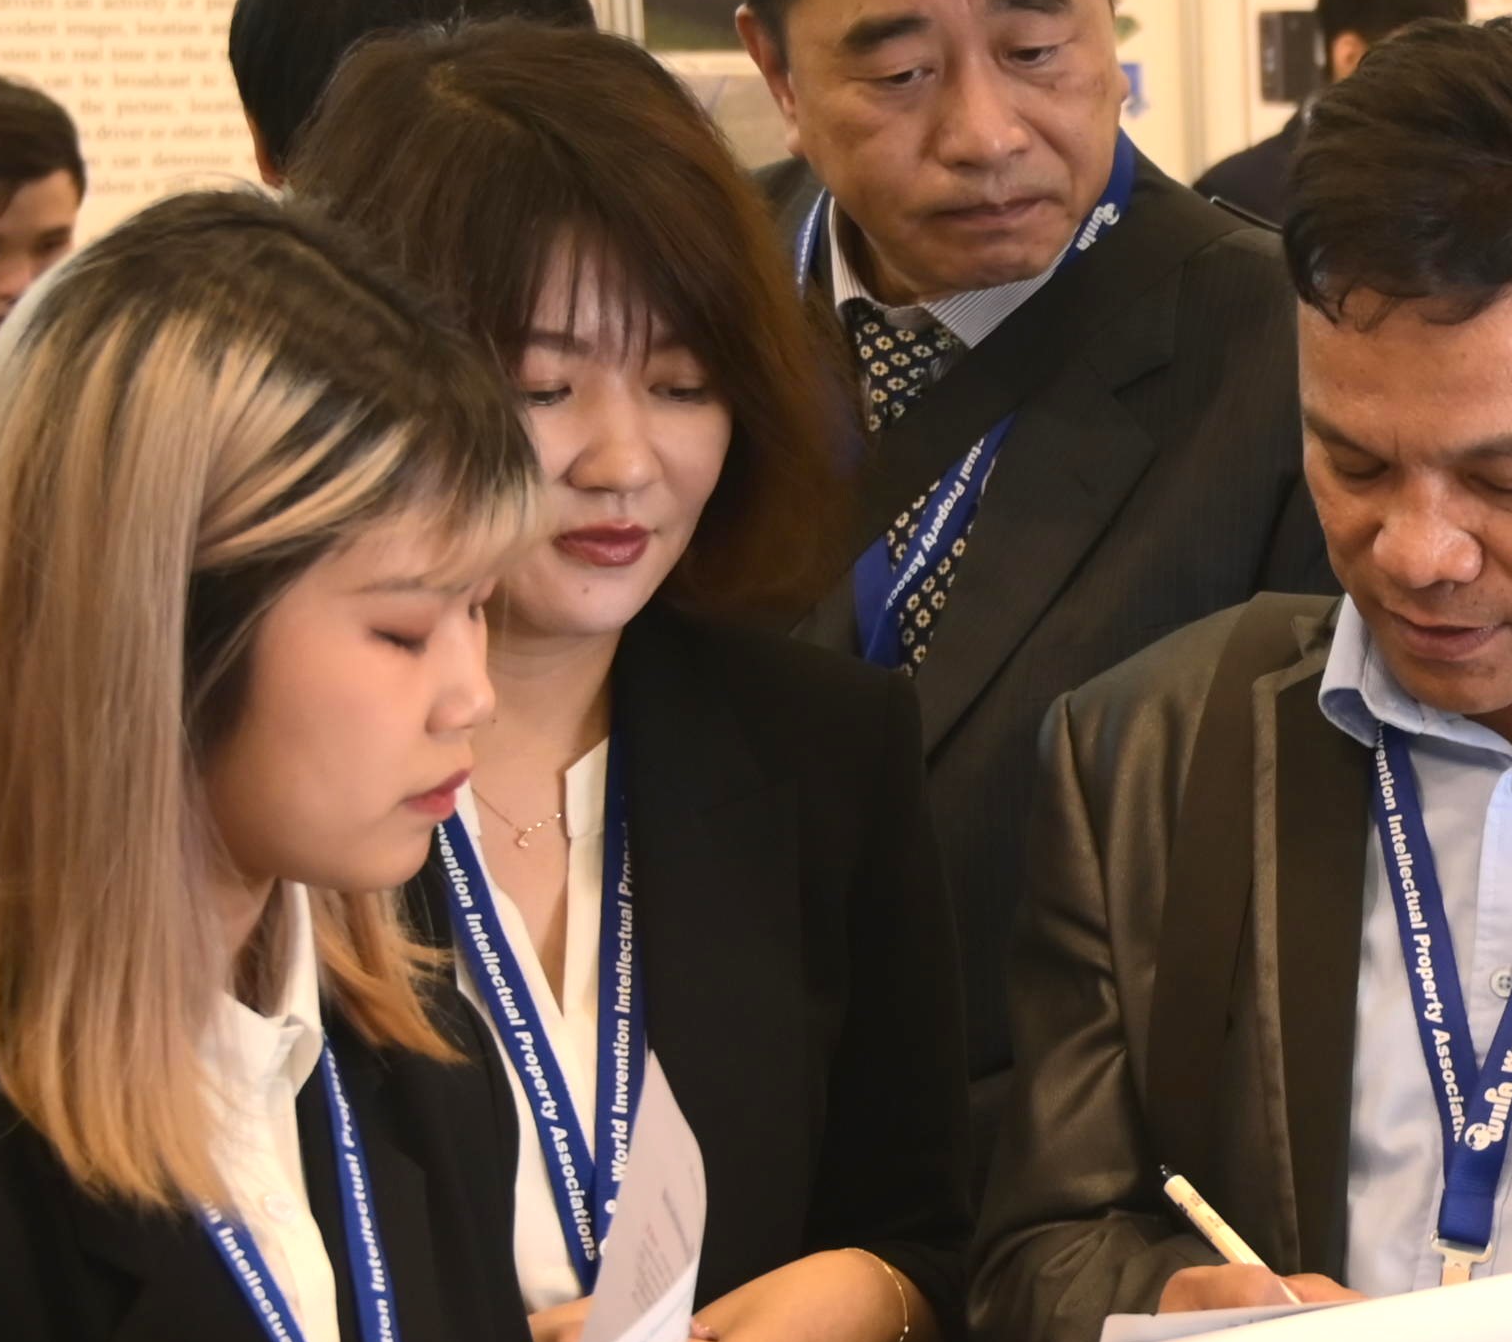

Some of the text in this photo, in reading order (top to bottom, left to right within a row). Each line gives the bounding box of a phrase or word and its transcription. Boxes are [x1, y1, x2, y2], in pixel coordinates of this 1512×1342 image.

[922, 480, 967, 552] Property
[1387, 813, 1444, 1025] Intellectual Property
[436, 822, 600, 1263] nvention Intellectual Property Associations
[611, 898, 635, 1184] World Invention Intellectual
[344, 1152, 386, 1292] Intellectual
